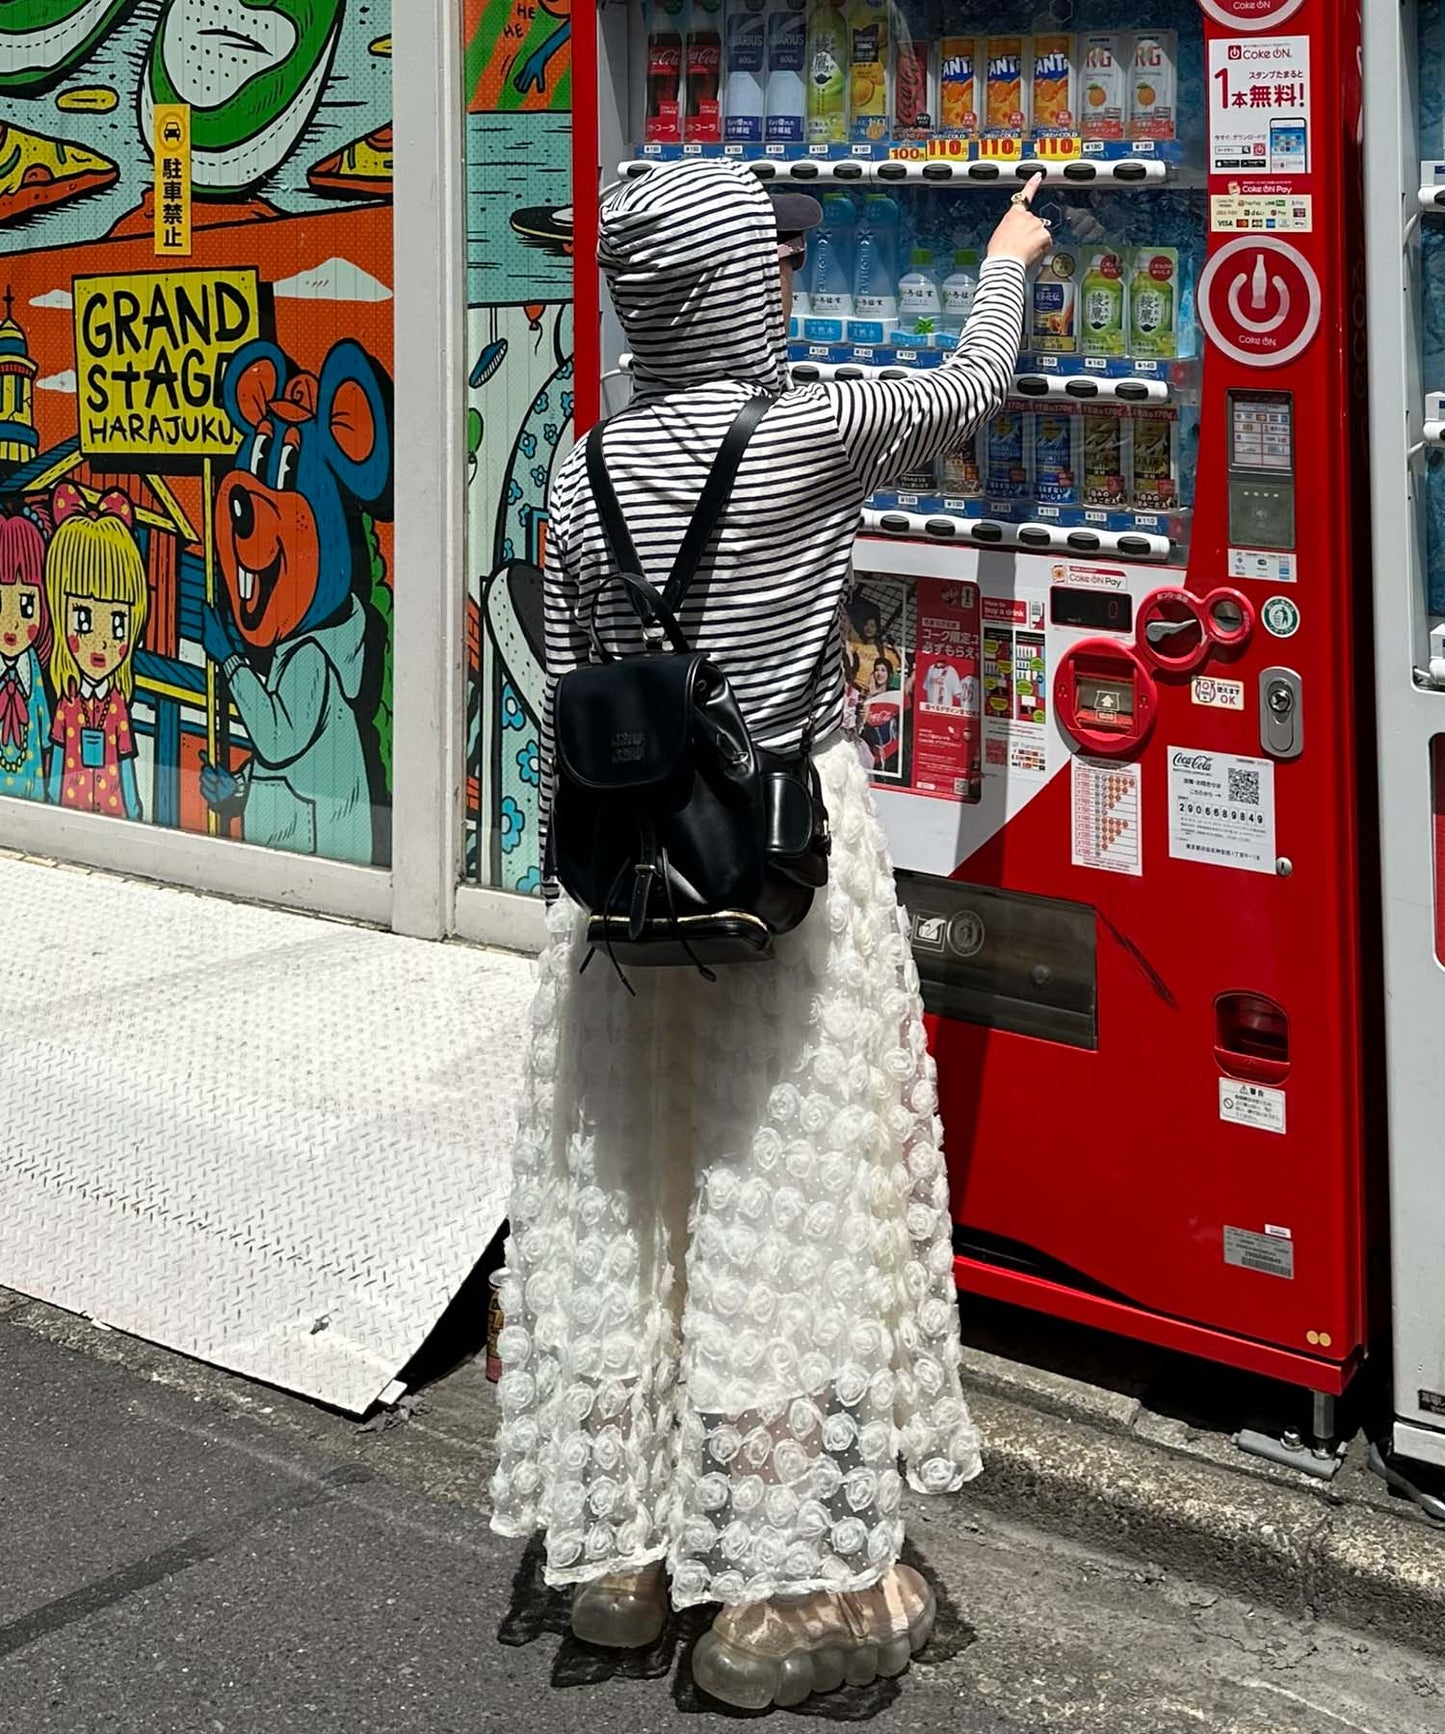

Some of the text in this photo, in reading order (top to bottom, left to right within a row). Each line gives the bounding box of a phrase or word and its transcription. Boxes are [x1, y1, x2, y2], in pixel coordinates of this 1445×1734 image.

[517, 4, 535, 19] HE
[1233, 1, 1271, 10] Coke ON
[504, 23, 523, 38] HE
[1243, 47, 1291, 60] Coke ON
[1249, 70, 1304, 79] スタンプたまると
[1214, 67, 1305, 109] 1本無料!
[1242, 184, 1292, 194] Coke ON Pay
[162, 158, 183, 247] 駐車禁止
[82, 281, 250, 358] GRAND
[1238, 335, 1276, 346] Coke ON
[89, 413, 234, 445] HARAJUKU
[1069, 573, 1121, 587] Coke ON Pay
[985, 607, 998, 615] buy
[1006, 609, 1025, 617] drink
[1108, 601, 1118, 619] 0
[1220, 695, 1236, 705] OK
[1180, 803, 1263, 824] 2906689849
